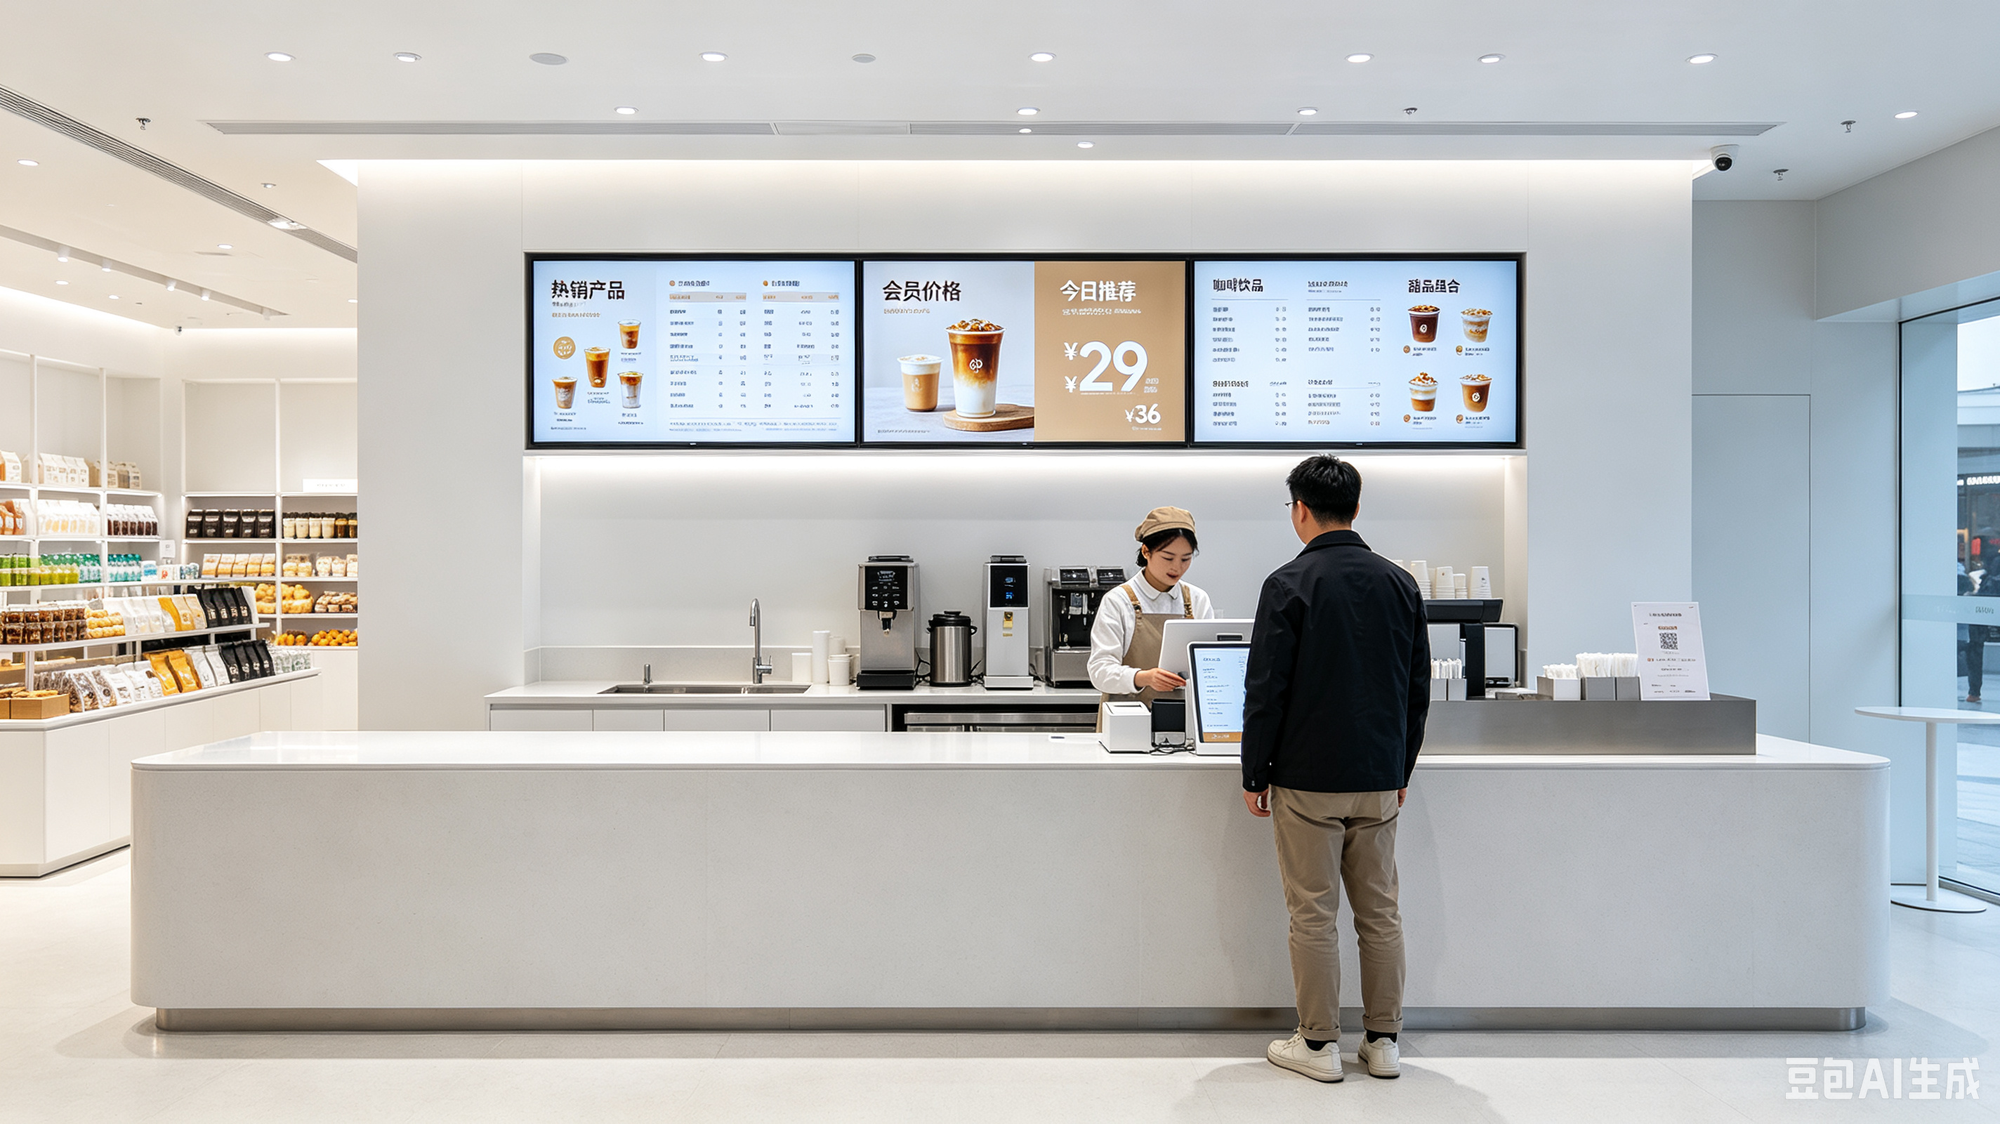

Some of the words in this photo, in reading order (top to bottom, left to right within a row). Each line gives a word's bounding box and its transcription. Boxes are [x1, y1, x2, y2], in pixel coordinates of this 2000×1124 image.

[551, 279, 625, 300] 热销产品
[882, 280, 962, 302] 会员价格
[1059, 279, 1137, 302] 今日推荐
[1124, 403, 1161, 425] ¥36
